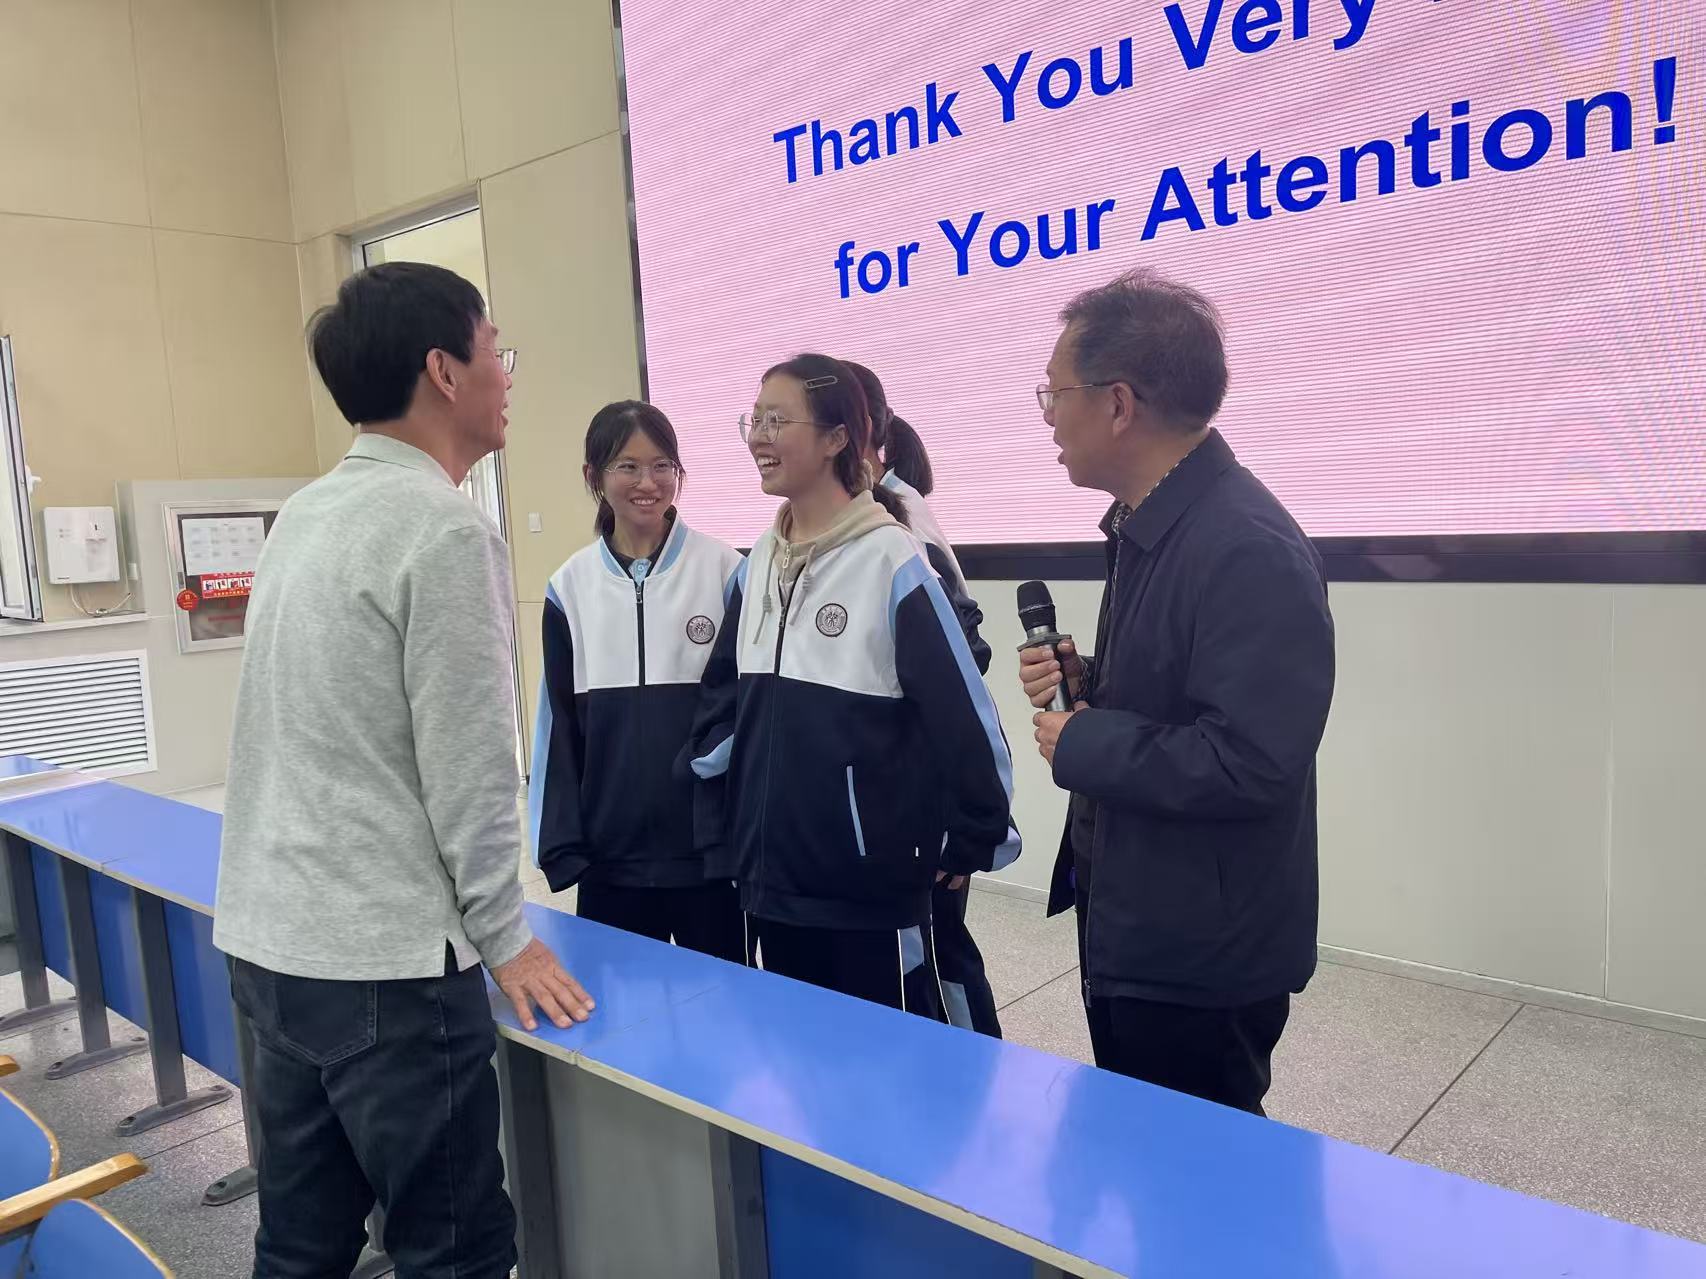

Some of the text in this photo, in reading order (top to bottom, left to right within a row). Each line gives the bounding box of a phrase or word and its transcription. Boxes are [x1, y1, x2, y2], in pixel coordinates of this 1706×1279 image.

[773, 81, 963, 184] Thank
[982, 37, 1133, 123] You
[834, 56, 1677, 299] for Your Attention!
